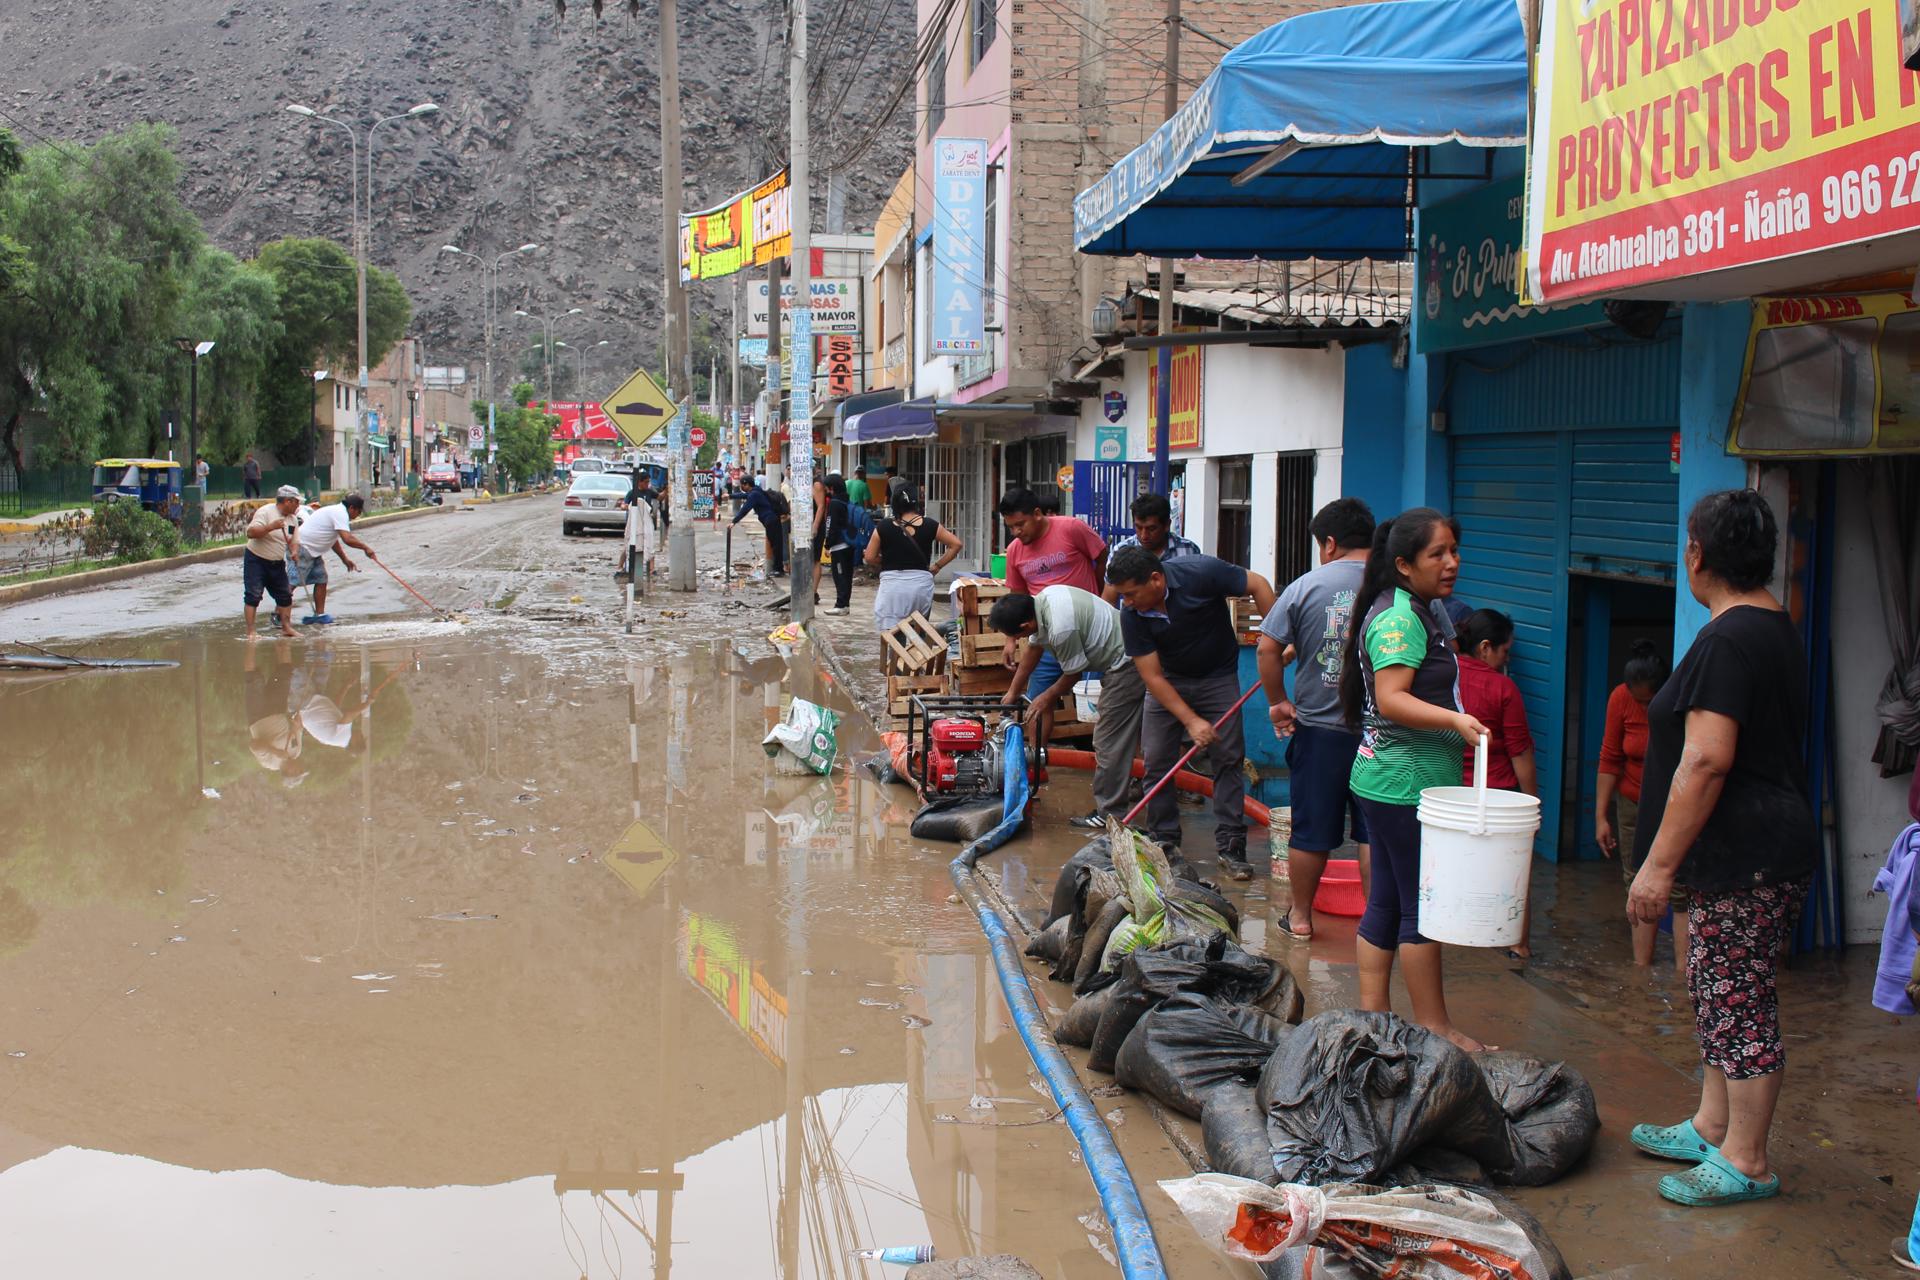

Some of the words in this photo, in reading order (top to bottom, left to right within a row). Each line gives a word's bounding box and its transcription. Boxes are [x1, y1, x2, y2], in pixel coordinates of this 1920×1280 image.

[1577, 0, 1799, 103] TAPIZAD
[1556, 49, 1790, 217] PROYECTOS
[1809, 8, 1876, 138] EN
[1118, 164, 1129, 205] EL
[1134, 133, 1164, 193] PULPO
[1551, 249, 1576, 285] Av.
[1579, 225, 1680, 279] Atahualpa
[1684, 207, 1725, 256] 381
[1744, 187, 1811, 243] Ñaña
[1822, 164, 1882, 224] 966
[946, 181, 973, 338] DENTAL
[839, 283, 848, 295] &
[1767, 296, 1864, 325] ROLLER
[817, 311, 856, 321] MAYOR
[936, 340, 982, 349] BRACKETS
[1103, 443, 1118, 454] plin
